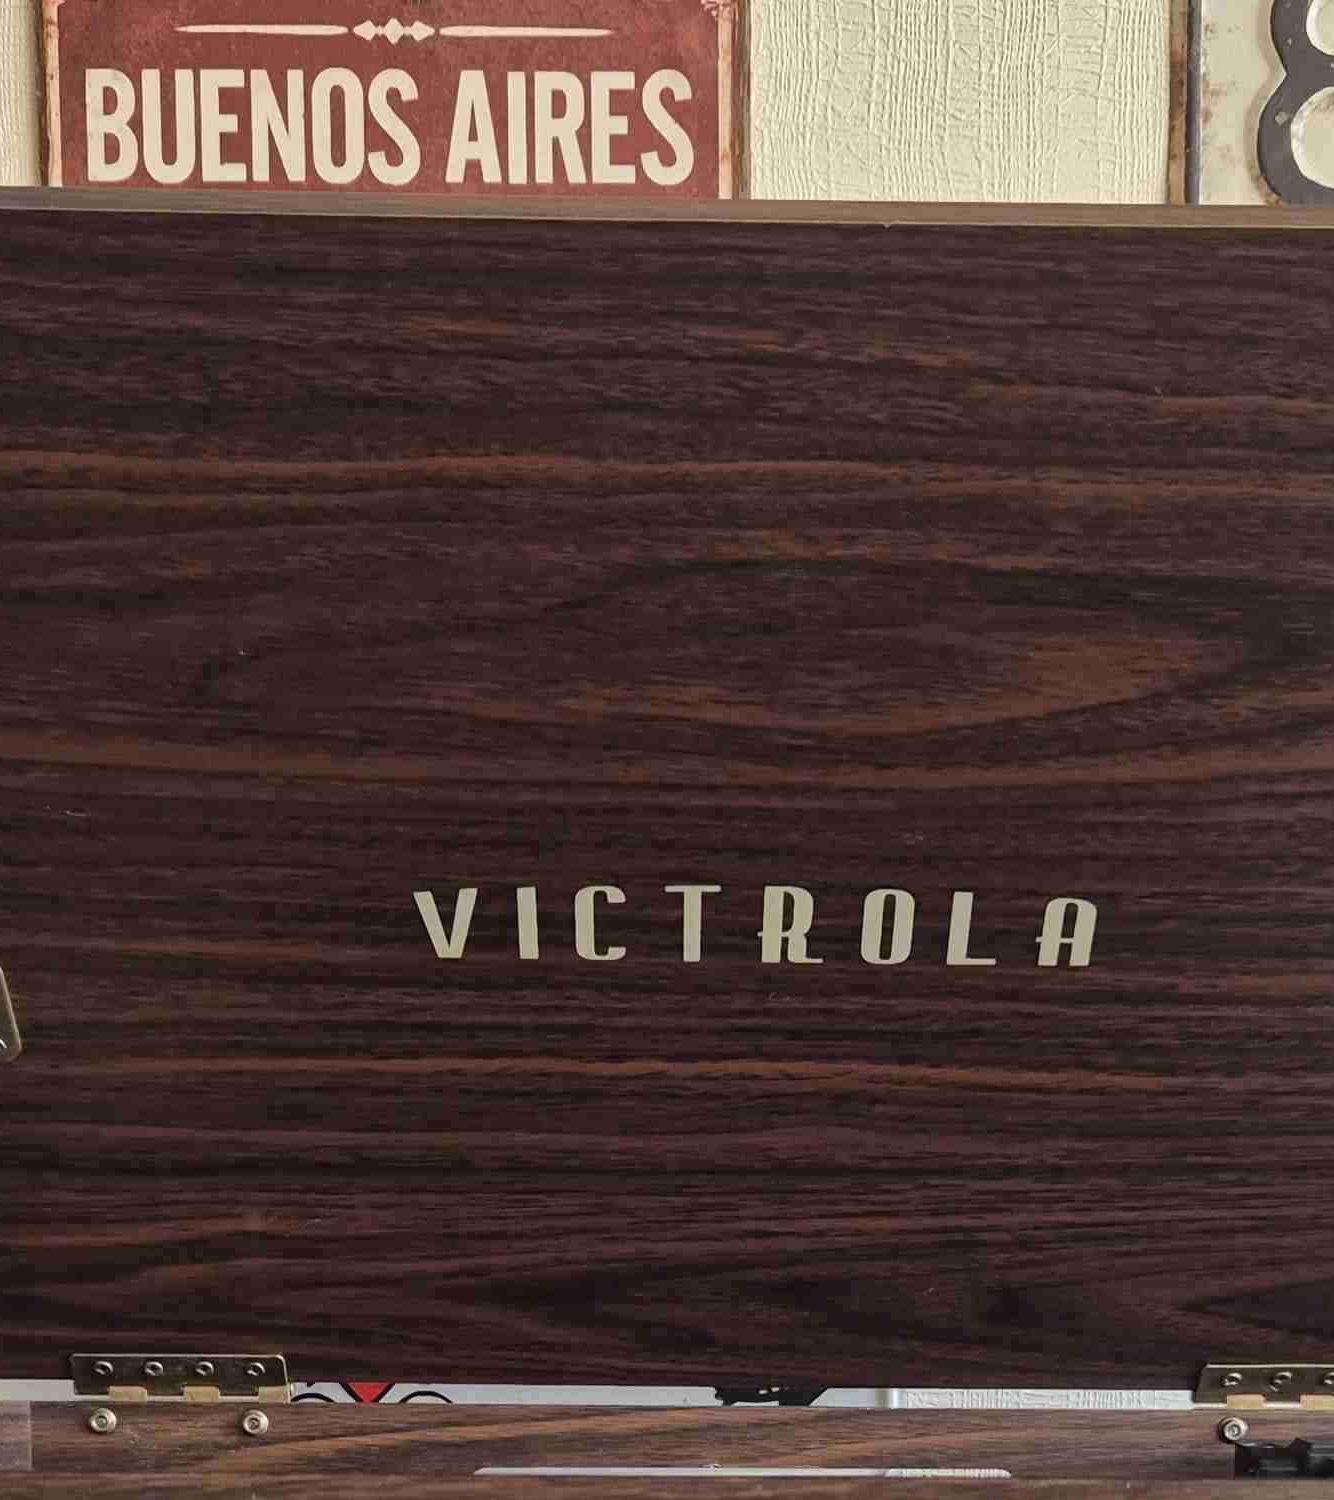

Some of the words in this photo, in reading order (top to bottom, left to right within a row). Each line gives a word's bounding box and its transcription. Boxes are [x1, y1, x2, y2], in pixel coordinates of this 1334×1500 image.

[85, 66, 422, 186] BUENOS
[446, 68, 695, 187] AIRES
[413, 884, 1098, 968] VICTROLA
